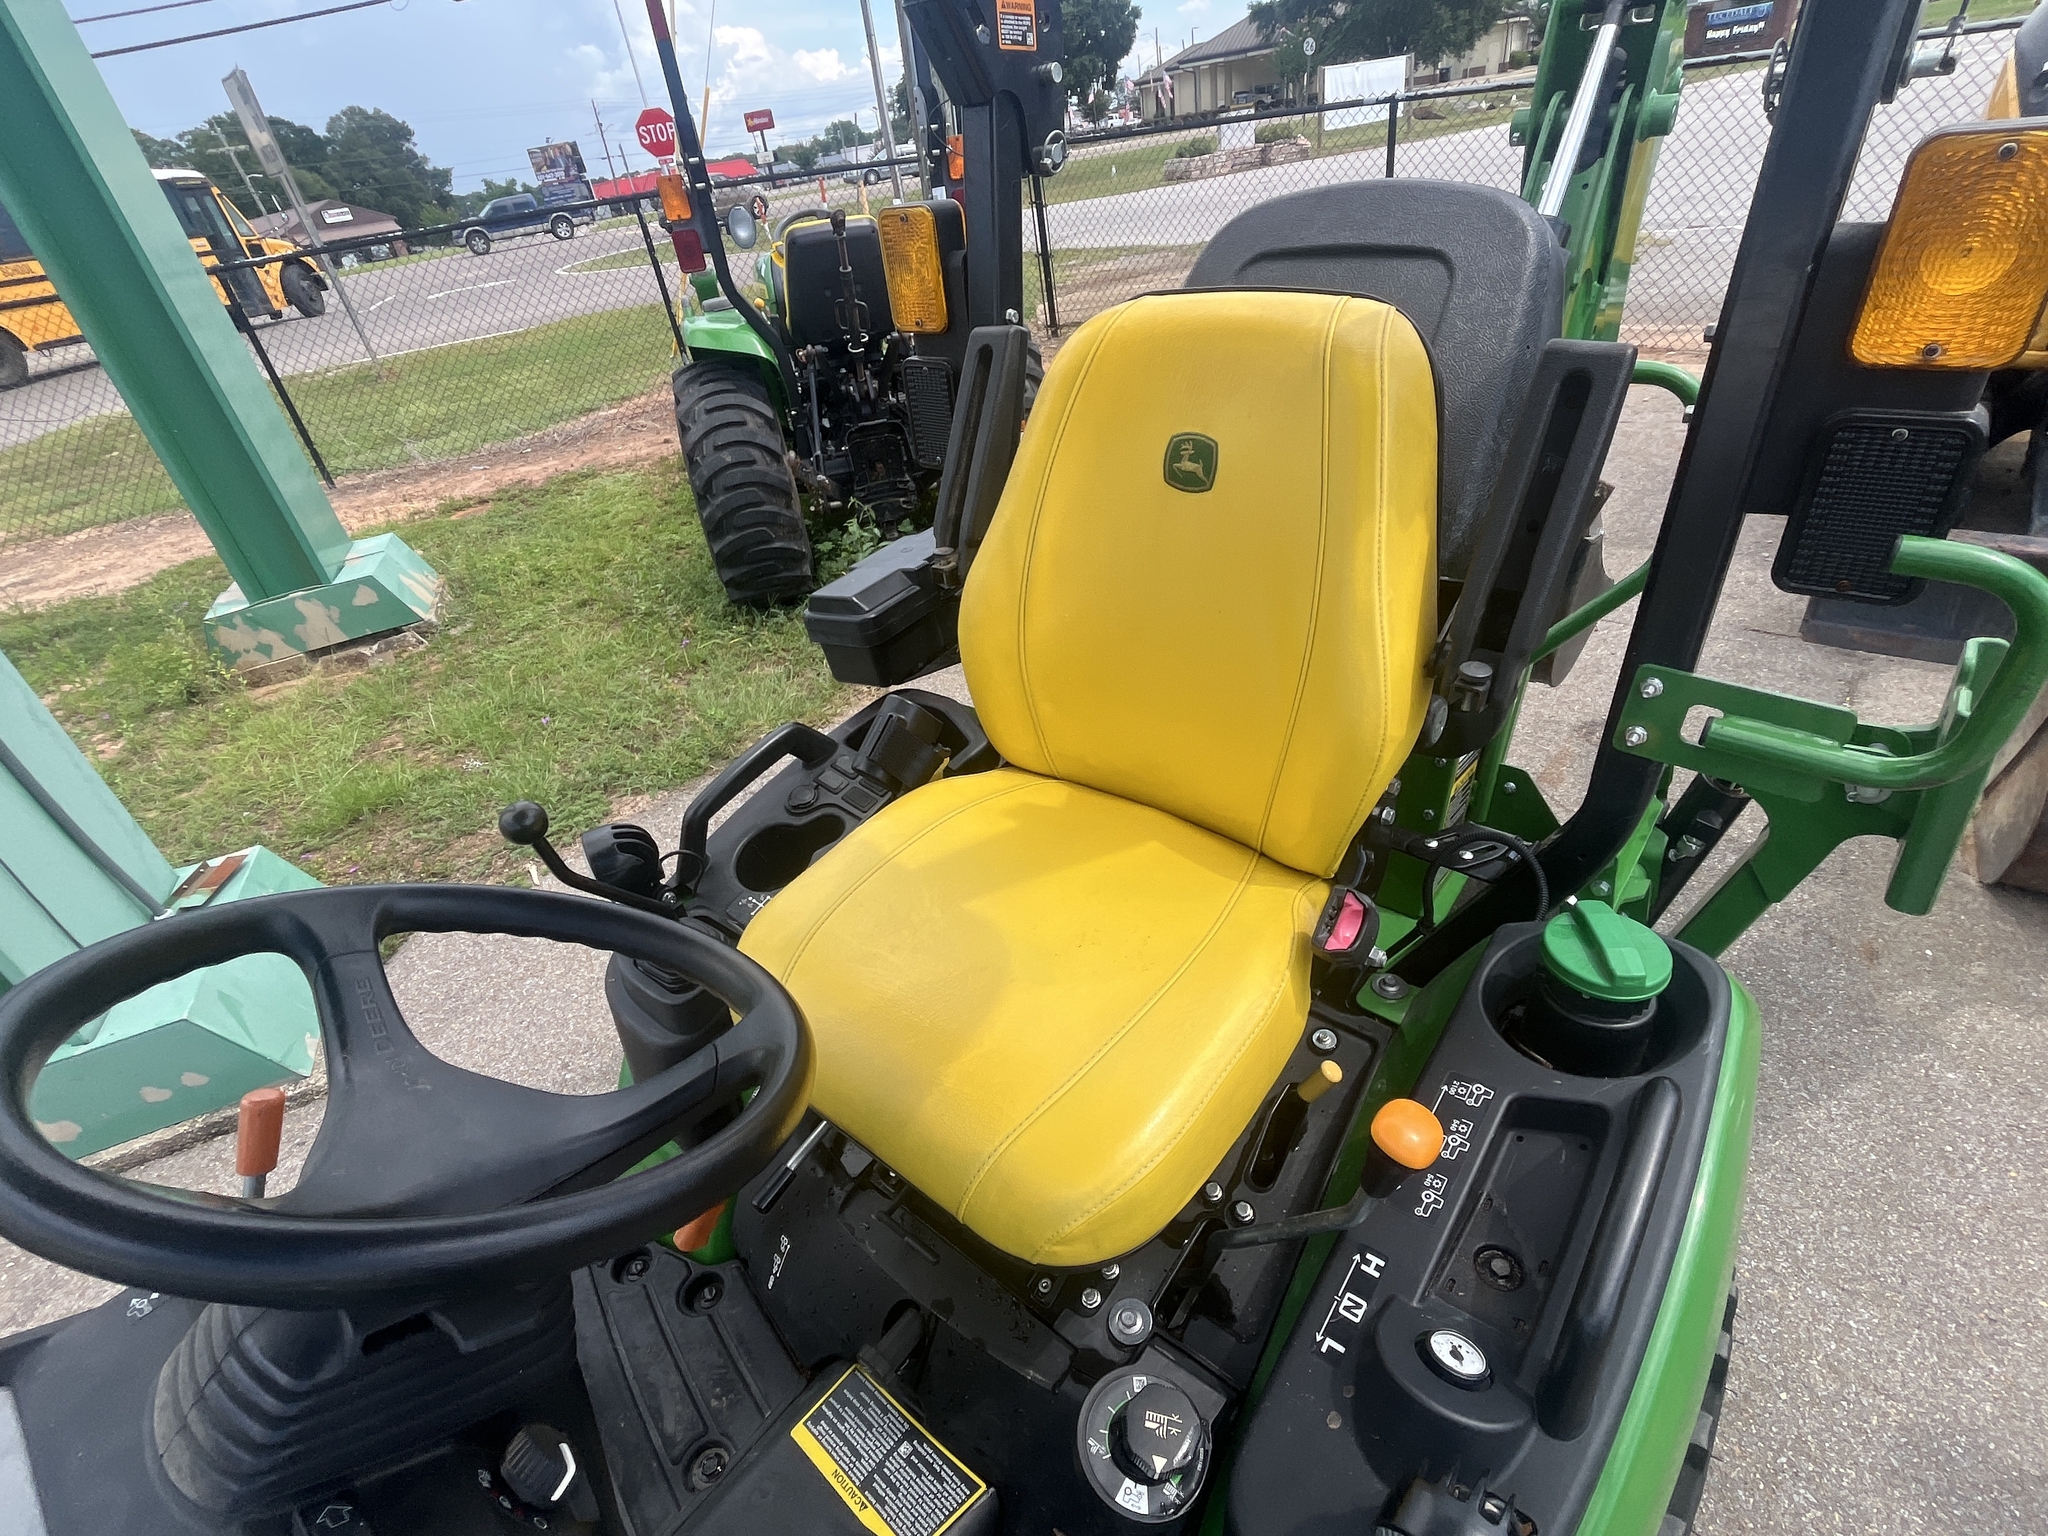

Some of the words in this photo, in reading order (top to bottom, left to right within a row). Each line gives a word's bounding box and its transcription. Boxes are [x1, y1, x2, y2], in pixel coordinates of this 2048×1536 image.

[1304, 41, 1315, 52] 26
[638, 122, 676, 145] STOP
[1449, 1080, 1460, 1096] 2100
[1450, 1118, 1461, 1132] 540
[1424, 1173, 1435, 1187] 540
[1360, 1252, 1386, 1279] H
[1320, 1336, 1347, 1354] L
[831, 1468, 863, 1506] CAUTION
